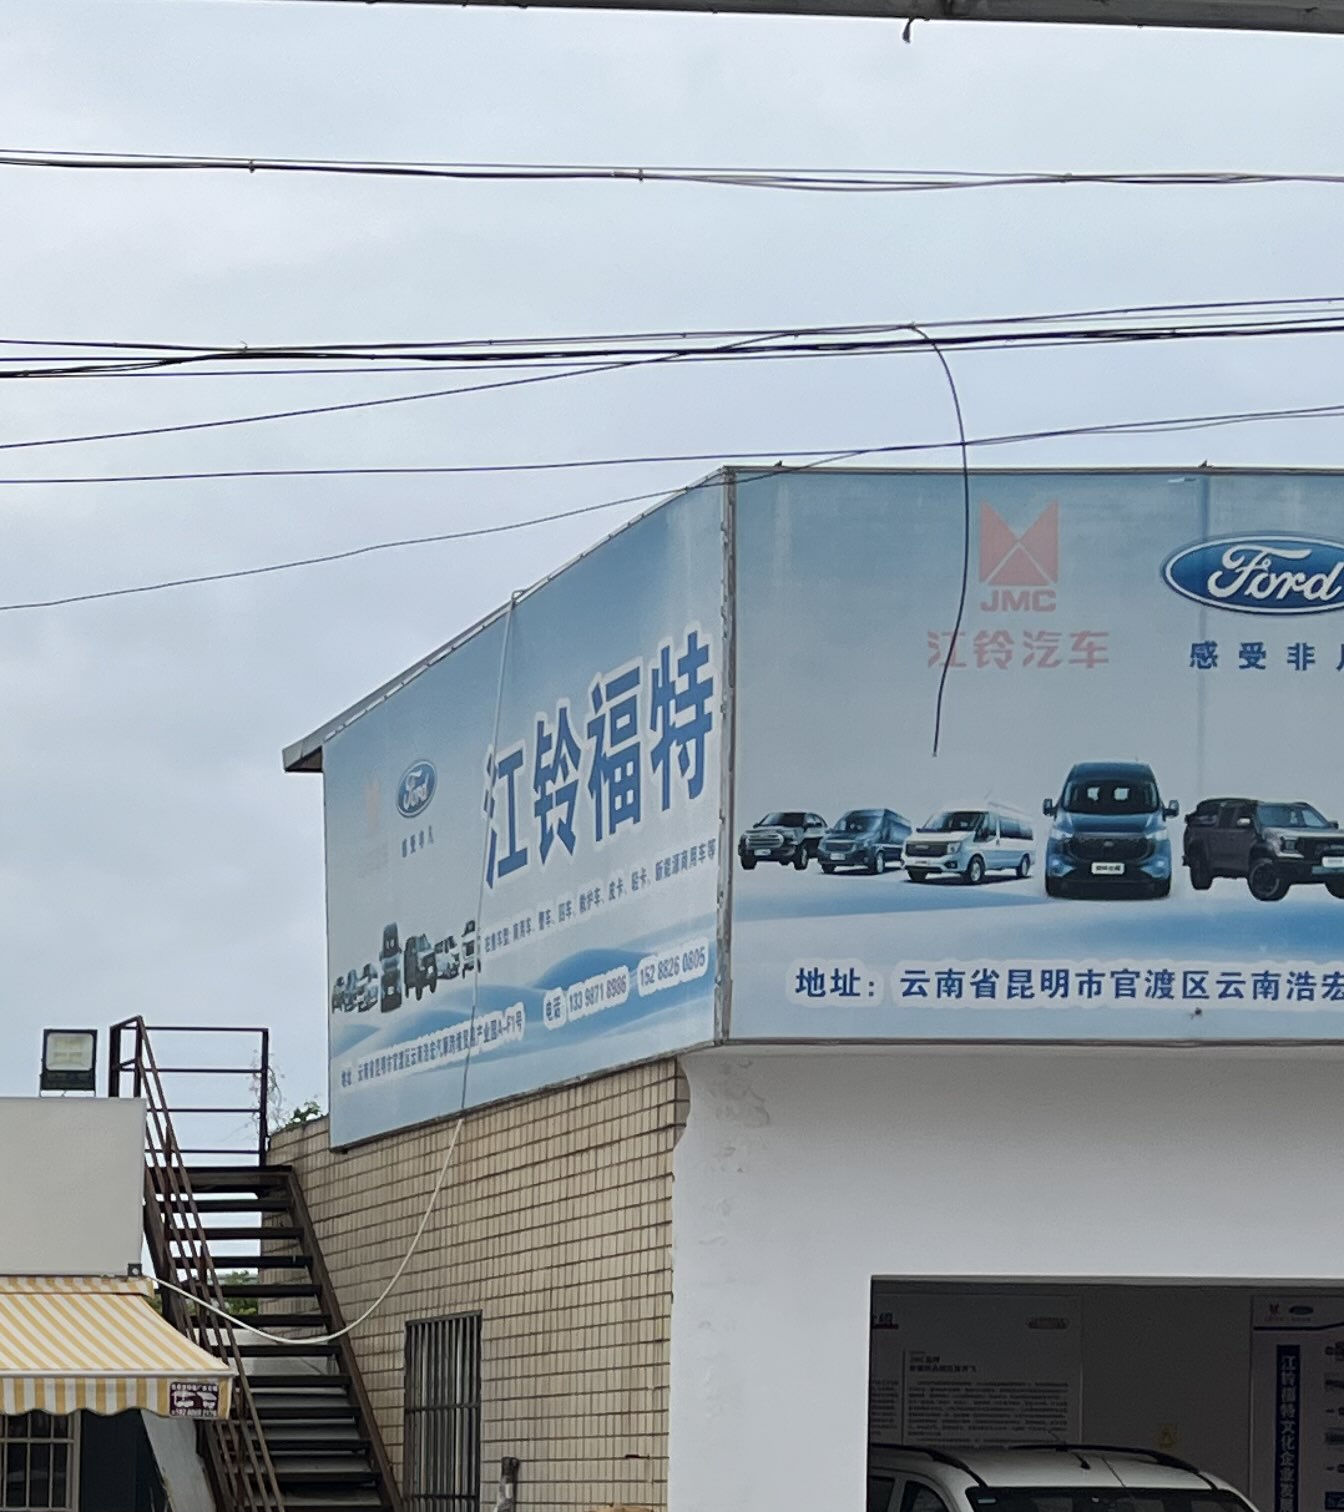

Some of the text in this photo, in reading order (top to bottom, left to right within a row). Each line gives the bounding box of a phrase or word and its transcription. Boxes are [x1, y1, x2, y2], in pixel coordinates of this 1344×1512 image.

[1207, 543, 1344, 601] Ford
[980, 589, 1057, 613] JMC
[927, 628, 1110, 670] 江铃汽车
[483, 629, 714, 890] 江铃福特
